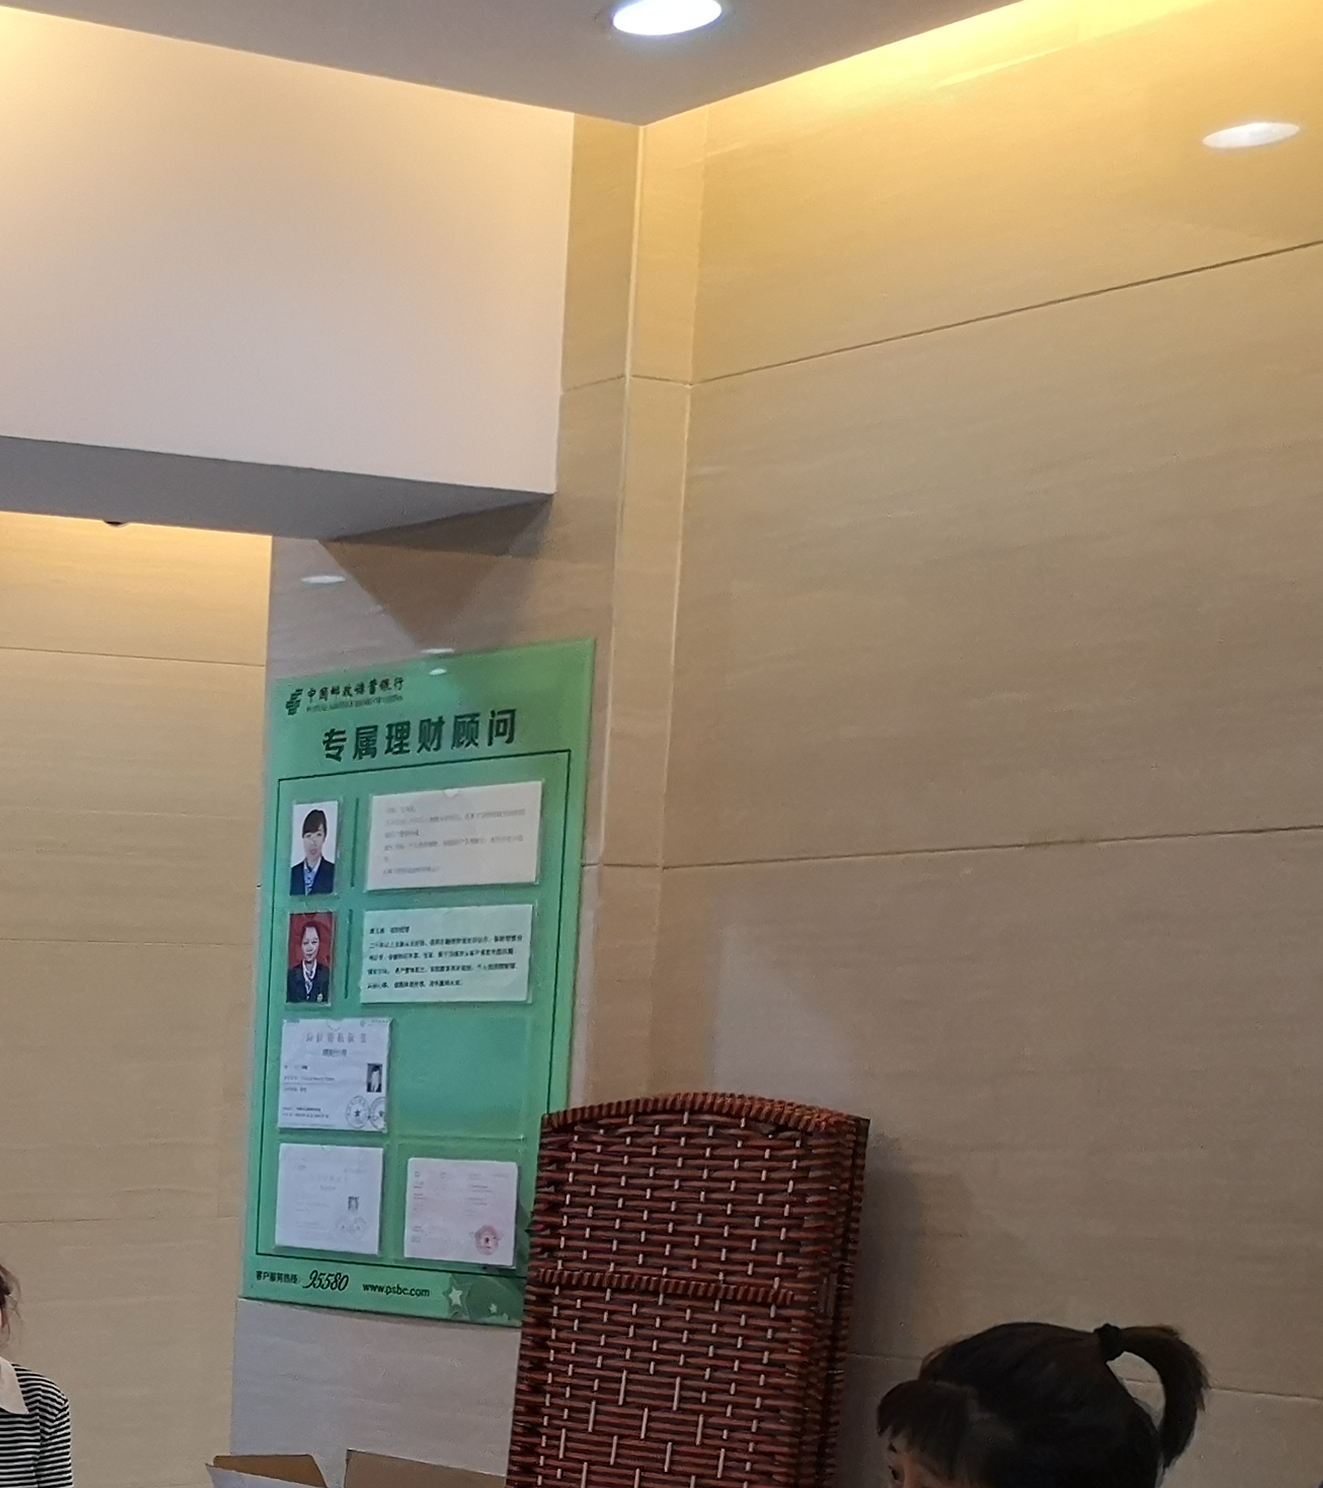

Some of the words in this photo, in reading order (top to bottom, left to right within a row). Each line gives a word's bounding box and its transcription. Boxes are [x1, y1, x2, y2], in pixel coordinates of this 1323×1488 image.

[322, 709, 517, 763] 专属理财顾问
[302, 1269, 350, 1292] 95580
[362, 1282, 431, 1298] www.psbc.com
